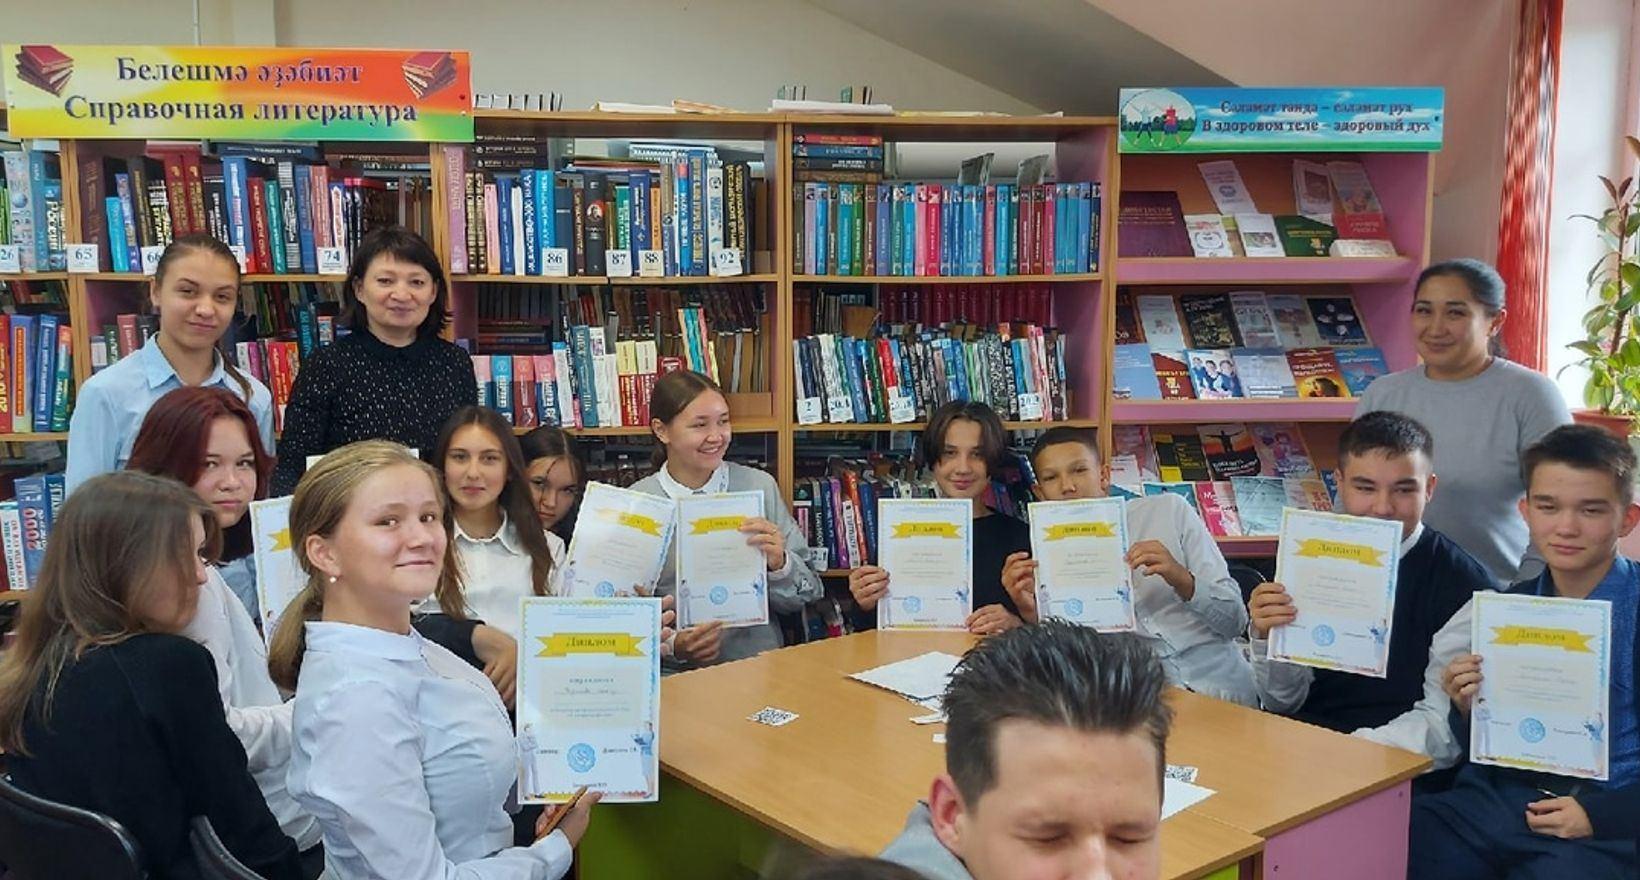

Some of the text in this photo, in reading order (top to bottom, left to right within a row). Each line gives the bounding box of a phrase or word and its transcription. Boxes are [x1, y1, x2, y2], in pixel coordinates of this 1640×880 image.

[117, 57, 248, 83] Белешмә
[64, 95, 419, 128] Справочная литература
[1202, 119, 1212, 132] В
[1215, 121, 1283, 133] здоровом
[1287, 121, 1319, 132] теле
[1333, 117, 1404, 133] здоровый
[1406, 121, 1430, 133] дух
[75, 249, 93, 260] 65
[324, 250, 341, 262] 74
[547, 253, 563, 264] 86
[612, 253, 627, 265] 87
[644, 253, 659, 264] 88
[719, 253, 735, 264] 92
[22, 507, 38, 551] 2000
